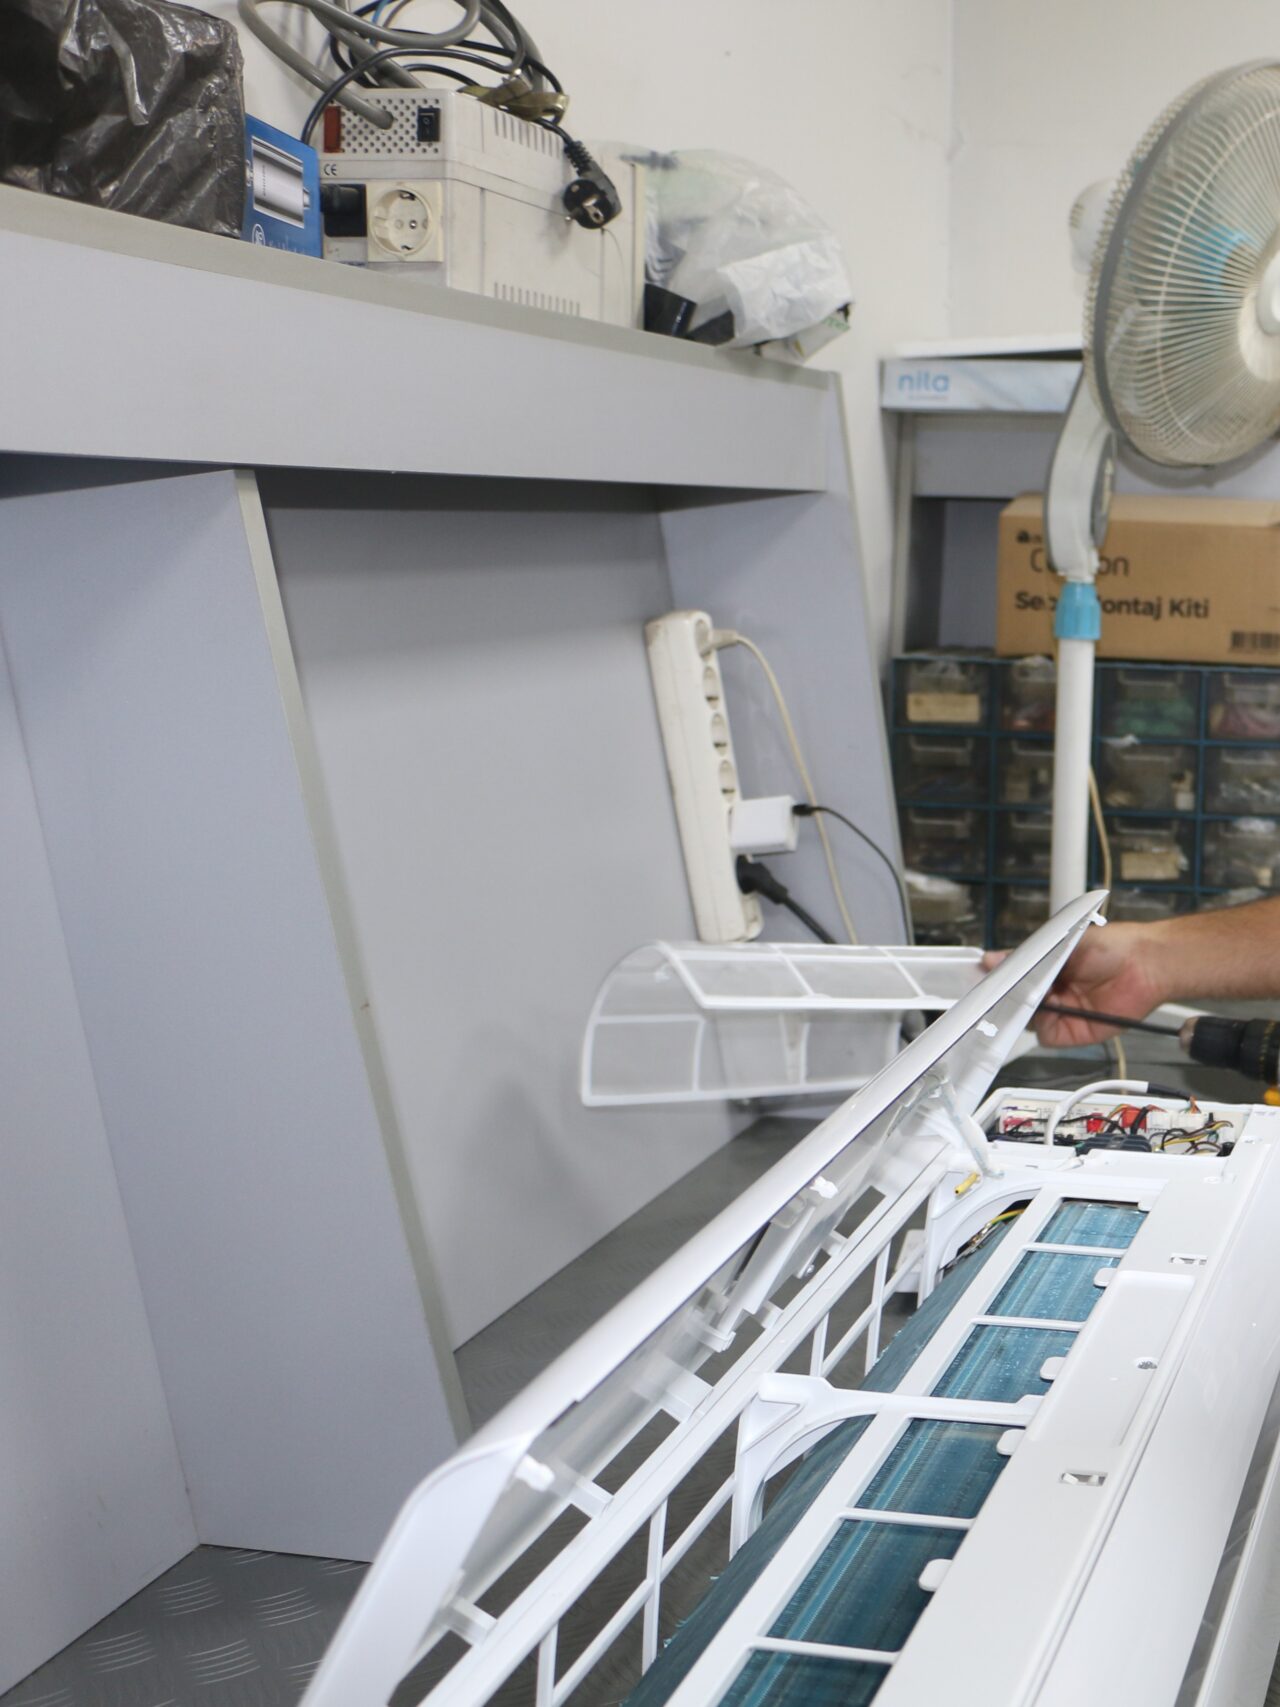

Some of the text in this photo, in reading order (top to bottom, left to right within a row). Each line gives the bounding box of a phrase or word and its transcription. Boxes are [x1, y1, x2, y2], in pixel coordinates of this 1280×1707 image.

[323, 163, 338, 176] CE
[1098, 596, 1209, 620] ontaj Kiti
